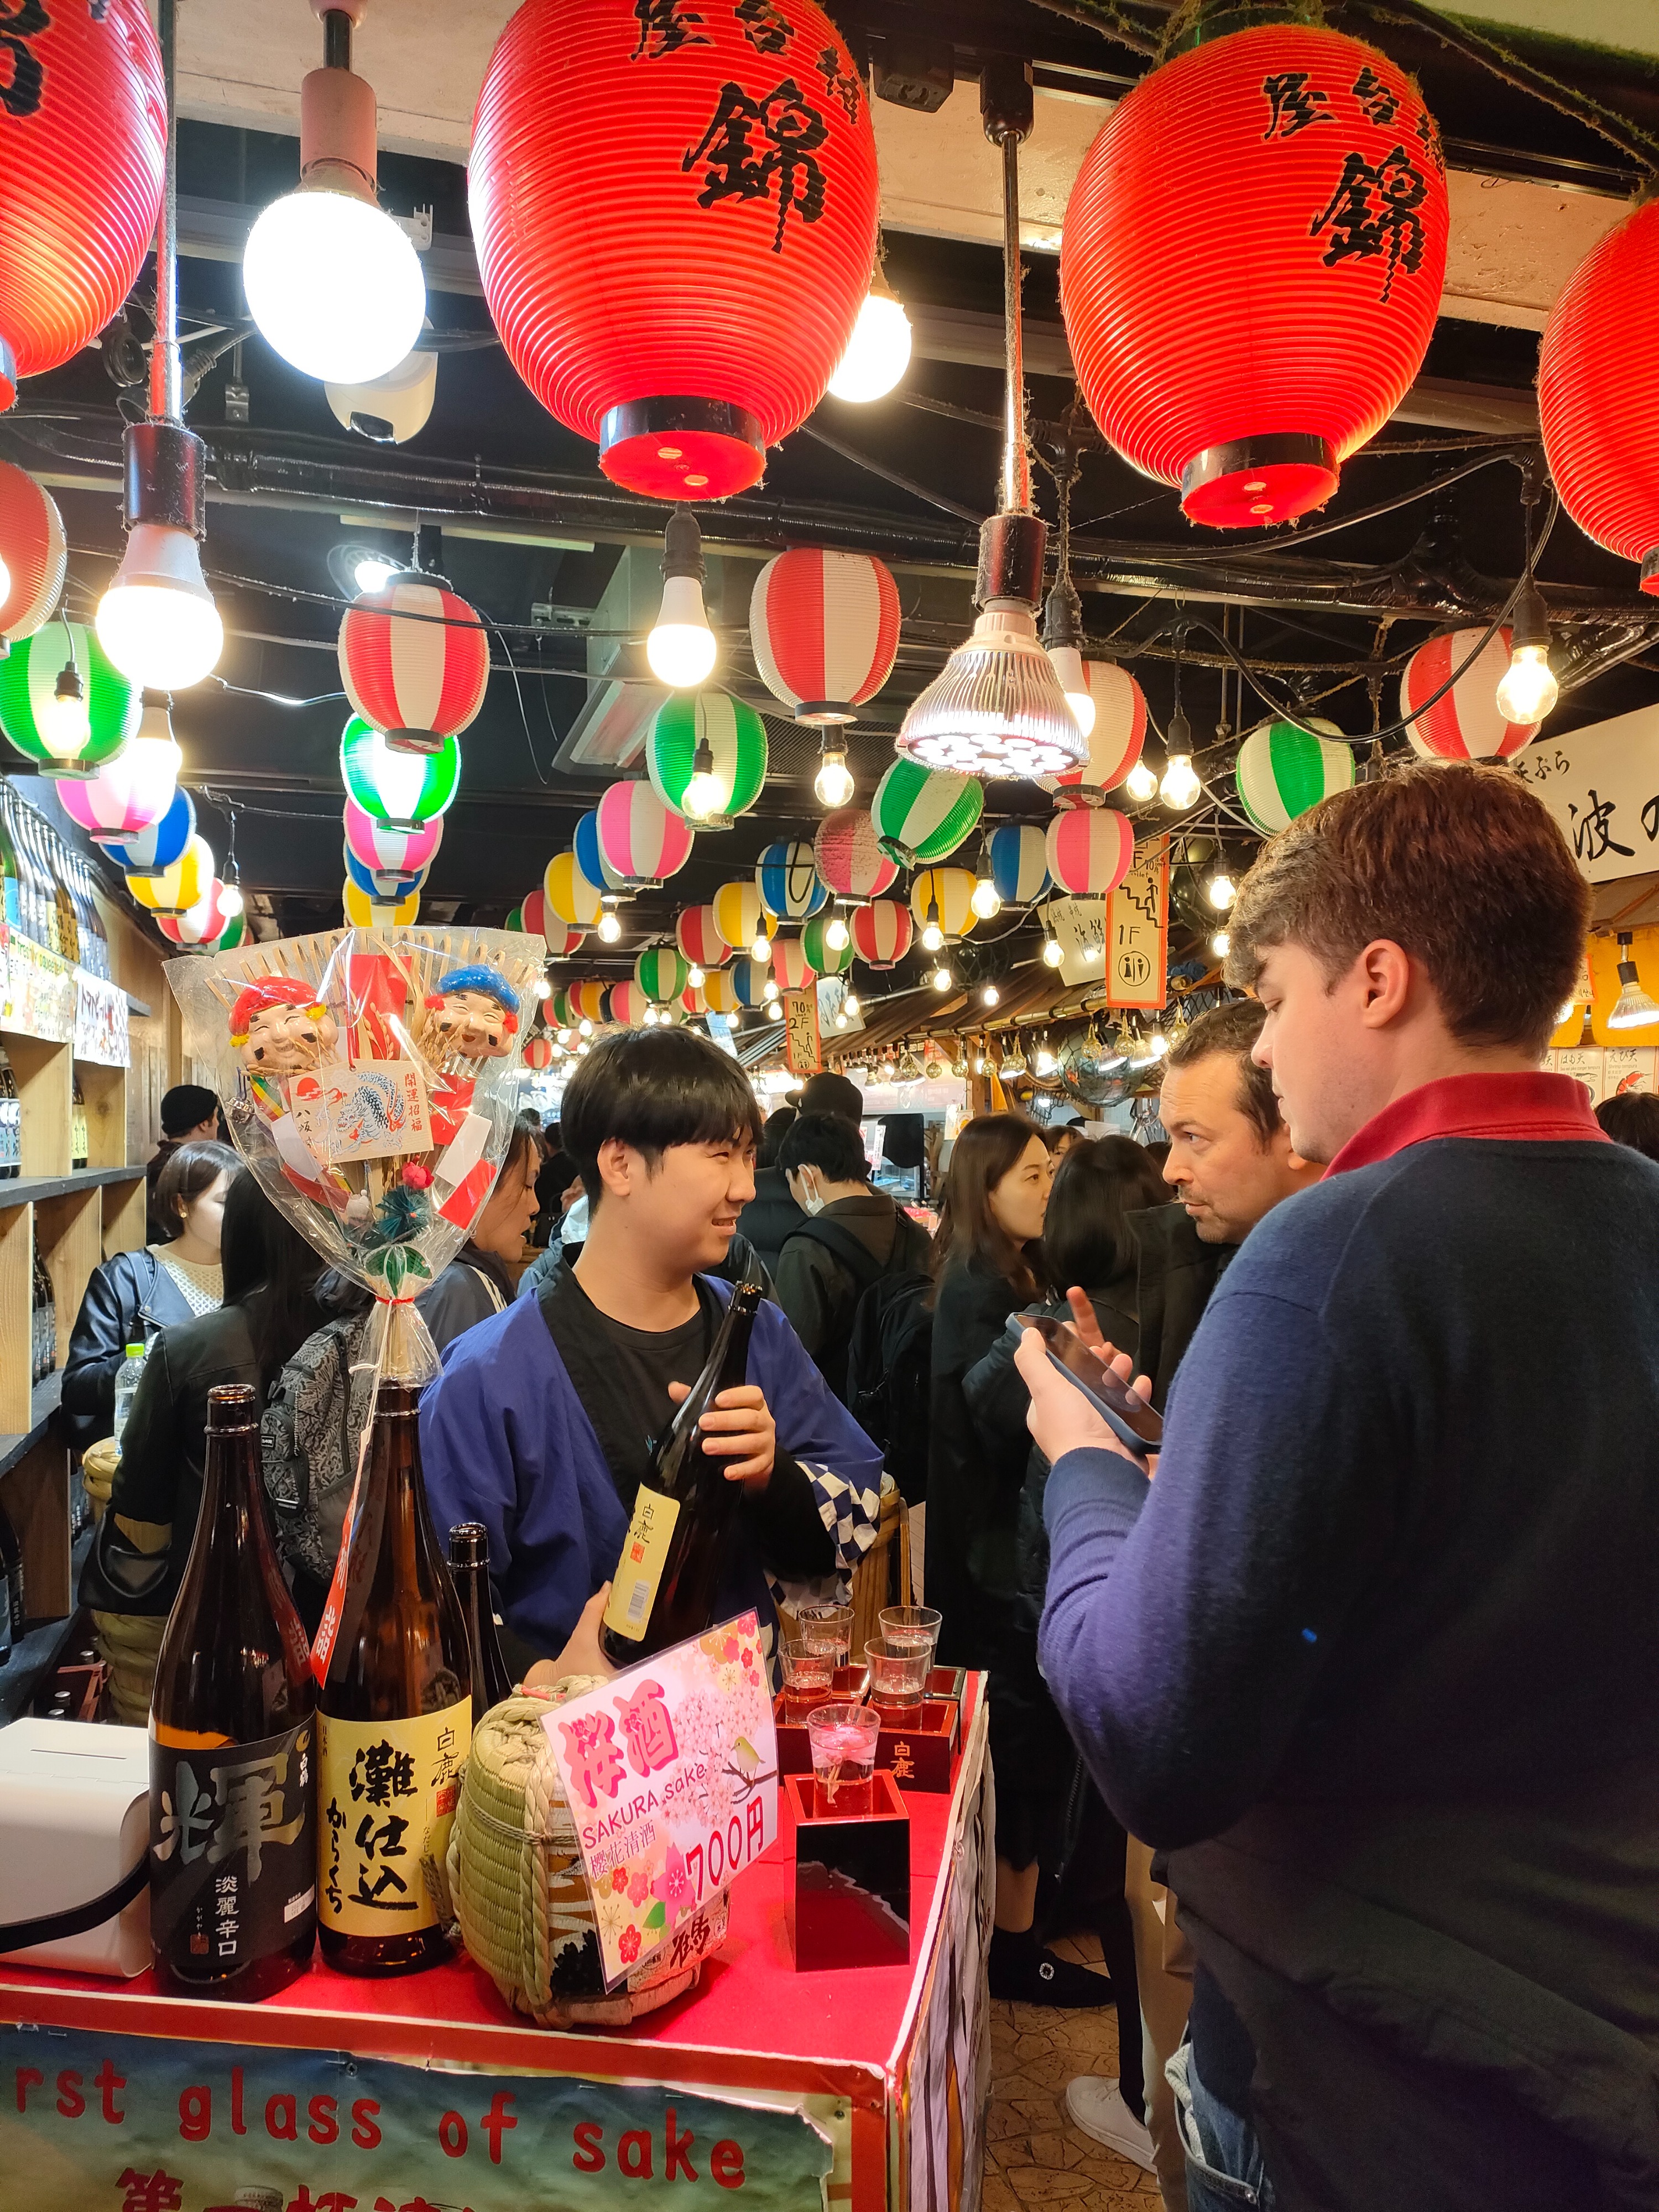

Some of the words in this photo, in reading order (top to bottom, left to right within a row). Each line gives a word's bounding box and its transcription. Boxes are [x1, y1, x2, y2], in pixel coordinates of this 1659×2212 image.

[681, 79, 828, 254] 錦
[1308, 145, 1428, 304] 錦
[1130, 851, 1144, 869] F
[1073, 916, 1106, 962] 海鮮
[1119, 925, 1141, 945] 1F
[789, 1018, 809, 1030] 2F
[792, 1001, 805, 1014] 70
[1561, 1052, 1585, 1065] はも天
[1610, 1048, 1637, 1062] えび天
[405, 1073, 422, 1132] 開運招福
[634, 1503, 655, 1544] 白鹿
[300, 1752, 309, 1788] 白鶴
[430, 1726, 460, 1787] 白鹿
[558, 1679, 679, 1809] 桜酒
[890, 1741, 915, 1778] 白鹿
[152, 1752, 305, 1887] 輝
[348, 1739, 419, 1911] 灘仕込
[582, 1789, 659, 1850] SAKURA
[589, 1819, 656, 1880] 樱花清酒
[685, 1795, 764, 1901] 700円
[325, 1797, 347, 1914] からくち
[215, 1875, 239, 1956] 淡麗辛口
[178, 2065, 383, 2150] glass
[439, 2091, 518, 2165] of
[572, 2107, 746, 2189] sake
